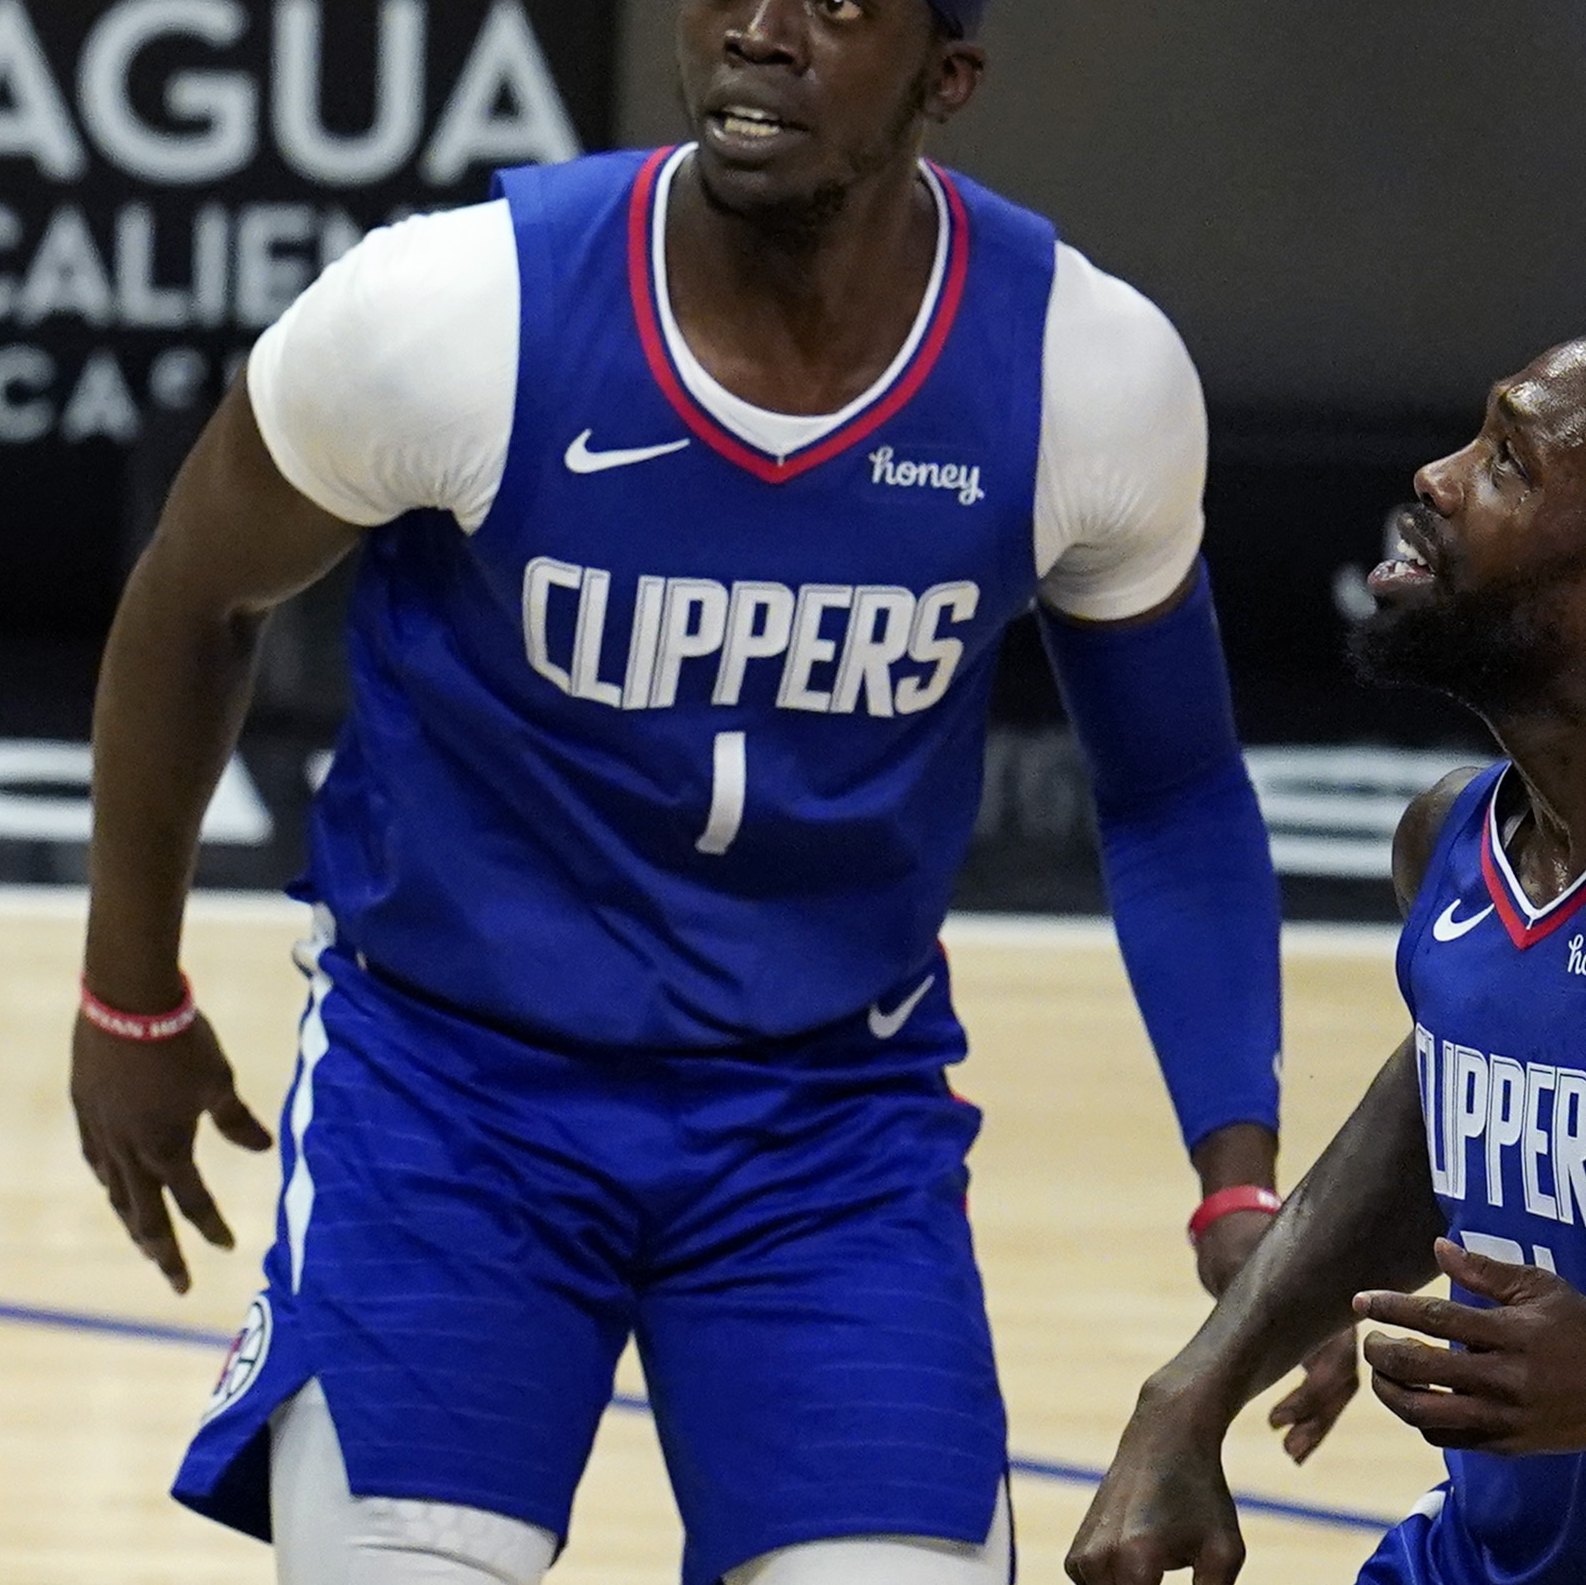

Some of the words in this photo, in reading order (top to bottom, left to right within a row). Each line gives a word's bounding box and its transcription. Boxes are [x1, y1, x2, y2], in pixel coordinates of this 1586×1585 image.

[869, 447, 985, 505] honey
[523, 557, 980, 717] CLIPPERS
[695, 731, 746, 854] 1
